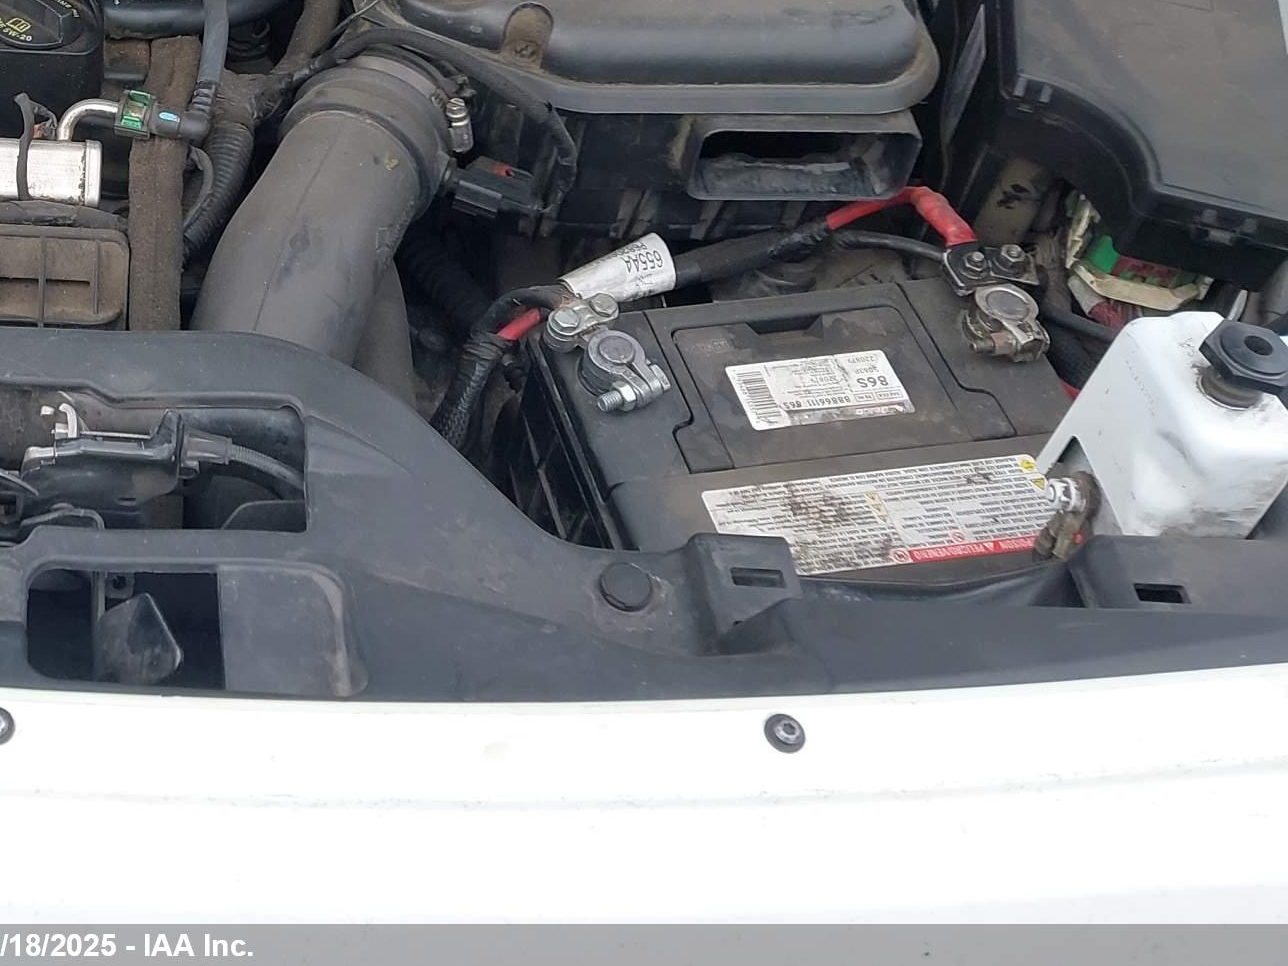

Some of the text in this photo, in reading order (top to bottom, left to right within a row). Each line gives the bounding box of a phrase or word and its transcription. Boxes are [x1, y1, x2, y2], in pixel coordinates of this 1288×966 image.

[3, 28, 32, 41] 5W-20
[620, 250, 663, 273] 655AA
[856, 375, 888, 388] 86S
